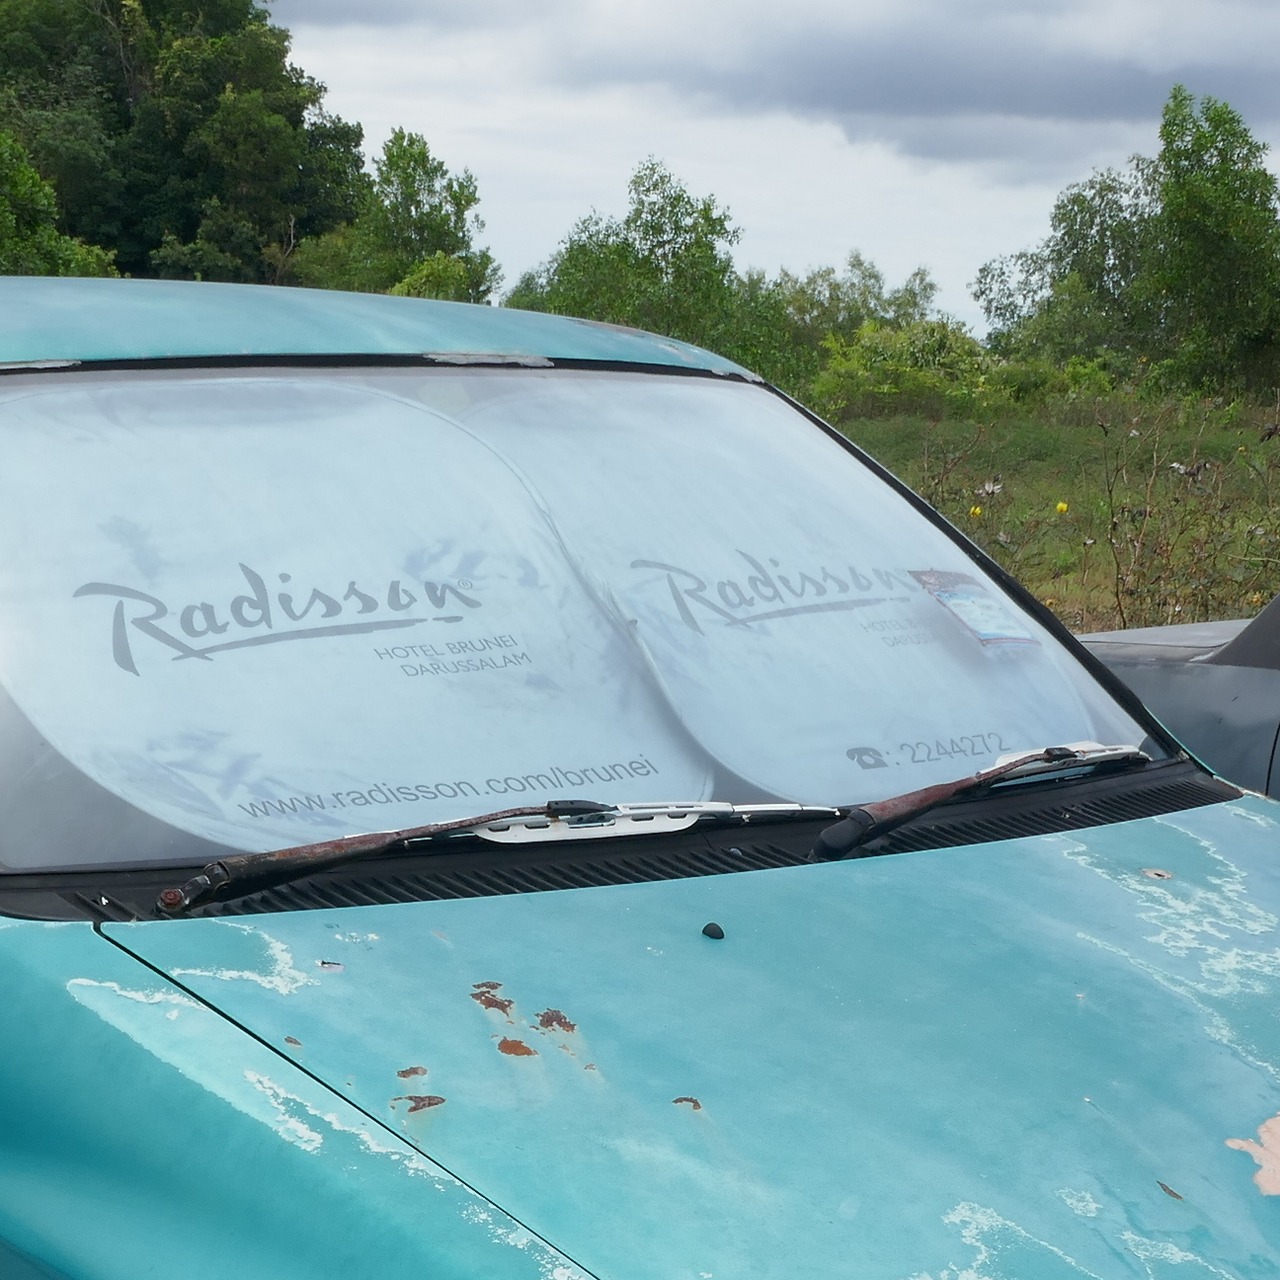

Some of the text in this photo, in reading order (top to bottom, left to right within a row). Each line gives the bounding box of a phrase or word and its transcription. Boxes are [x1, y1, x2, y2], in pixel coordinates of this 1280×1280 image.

[73, 563, 483, 677] Radisson
[374, 634, 518, 660] HOTEL BRUNEI
[400, 652, 532, 677] DARUSSALAM
[900, 732, 1011, 764] 2244272
[238, 754, 660, 818] www.radisson.com/brunei
